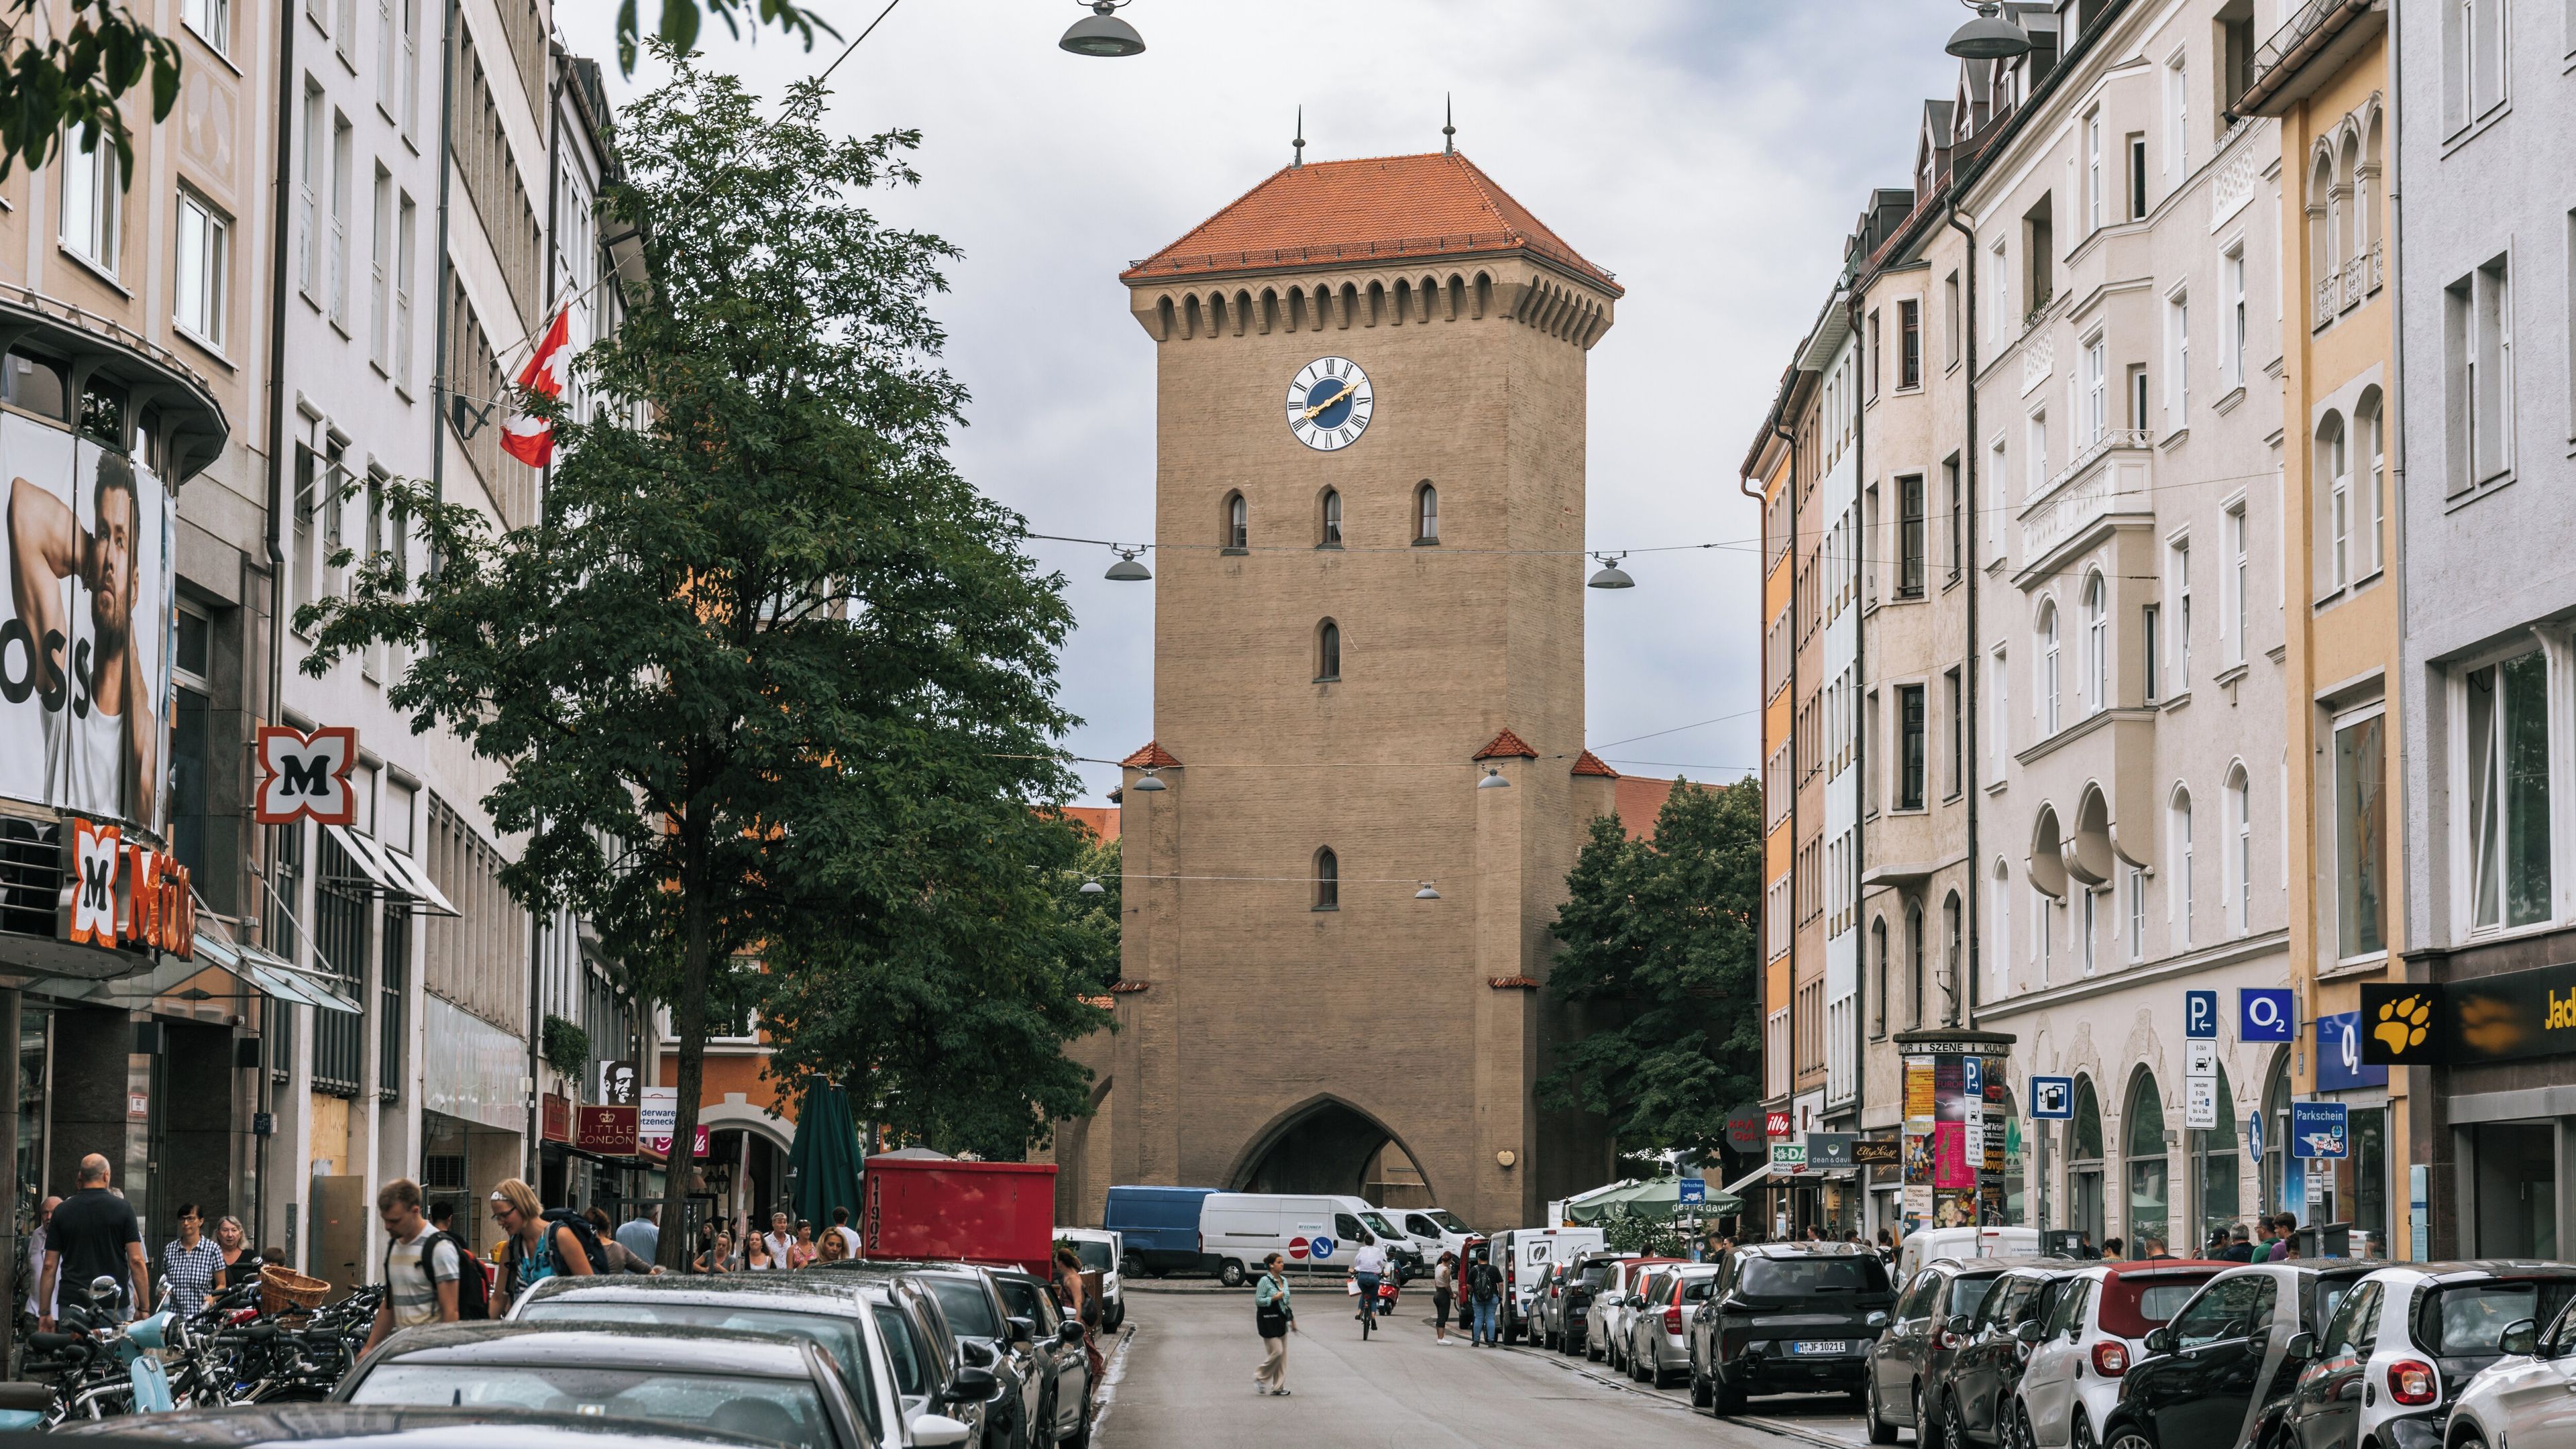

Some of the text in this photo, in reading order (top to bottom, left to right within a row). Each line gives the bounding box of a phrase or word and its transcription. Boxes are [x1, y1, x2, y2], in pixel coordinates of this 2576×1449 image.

[280, 755, 331, 796] M
[83, 856, 109, 911] M
[2192, 997, 2207, 1031] P
[1929, 1043, 1964, 1052] SZENE
[1984, 1044, 2009, 1053] KULTUR
[1967, 1063, 1976, 1089] P
[641, 1109, 676, 1117] derware
[2297, 1110, 2344, 1121] Parkschein
[579, 1125, 634, 1134] LITTLE
[1767, 1115, 1789, 1134] illy
[578, 1135, 634, 1144] LONDON
[1787, 1148, 1805, 1161] DA
[1799, 1343, 1804, 1352] M
[1809, 1342, 1819, 1351] JF
